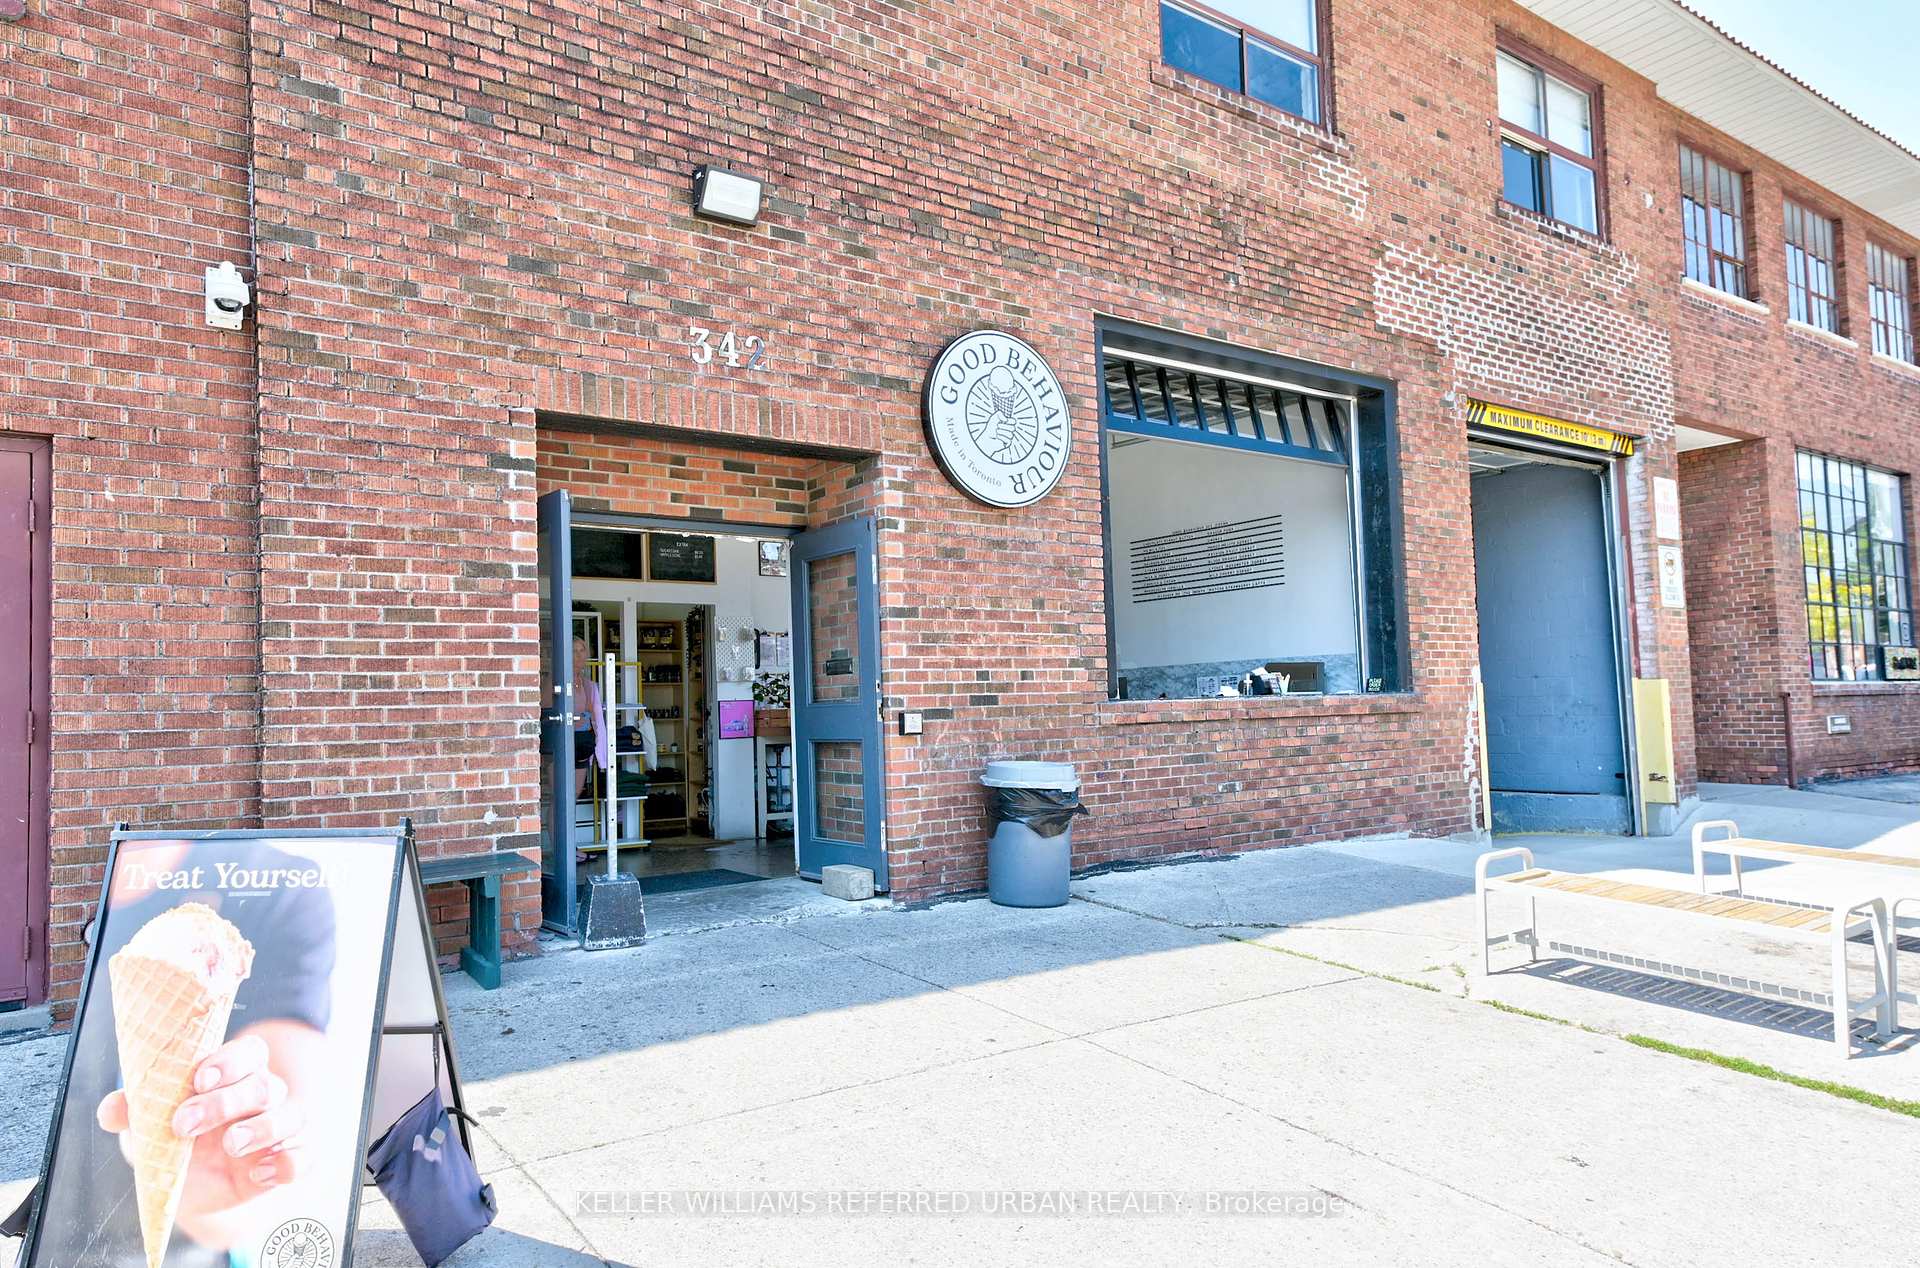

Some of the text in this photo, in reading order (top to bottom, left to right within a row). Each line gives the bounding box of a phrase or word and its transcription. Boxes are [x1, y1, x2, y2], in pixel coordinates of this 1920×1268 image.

[690, 326, 769, 372] 342
[940, 343, 1062, 494] GOOD BEHAVIOUR
[1489, 411, 1533, 430] MAXIMUM
[1534, 420, 1580, 441] CLEARANCE
[945, 416, 1002, 488] Made in Toronto
[124, 862, 340, 890] Treat Yoursel
[266, 1222, 300, 1256] GOOD
